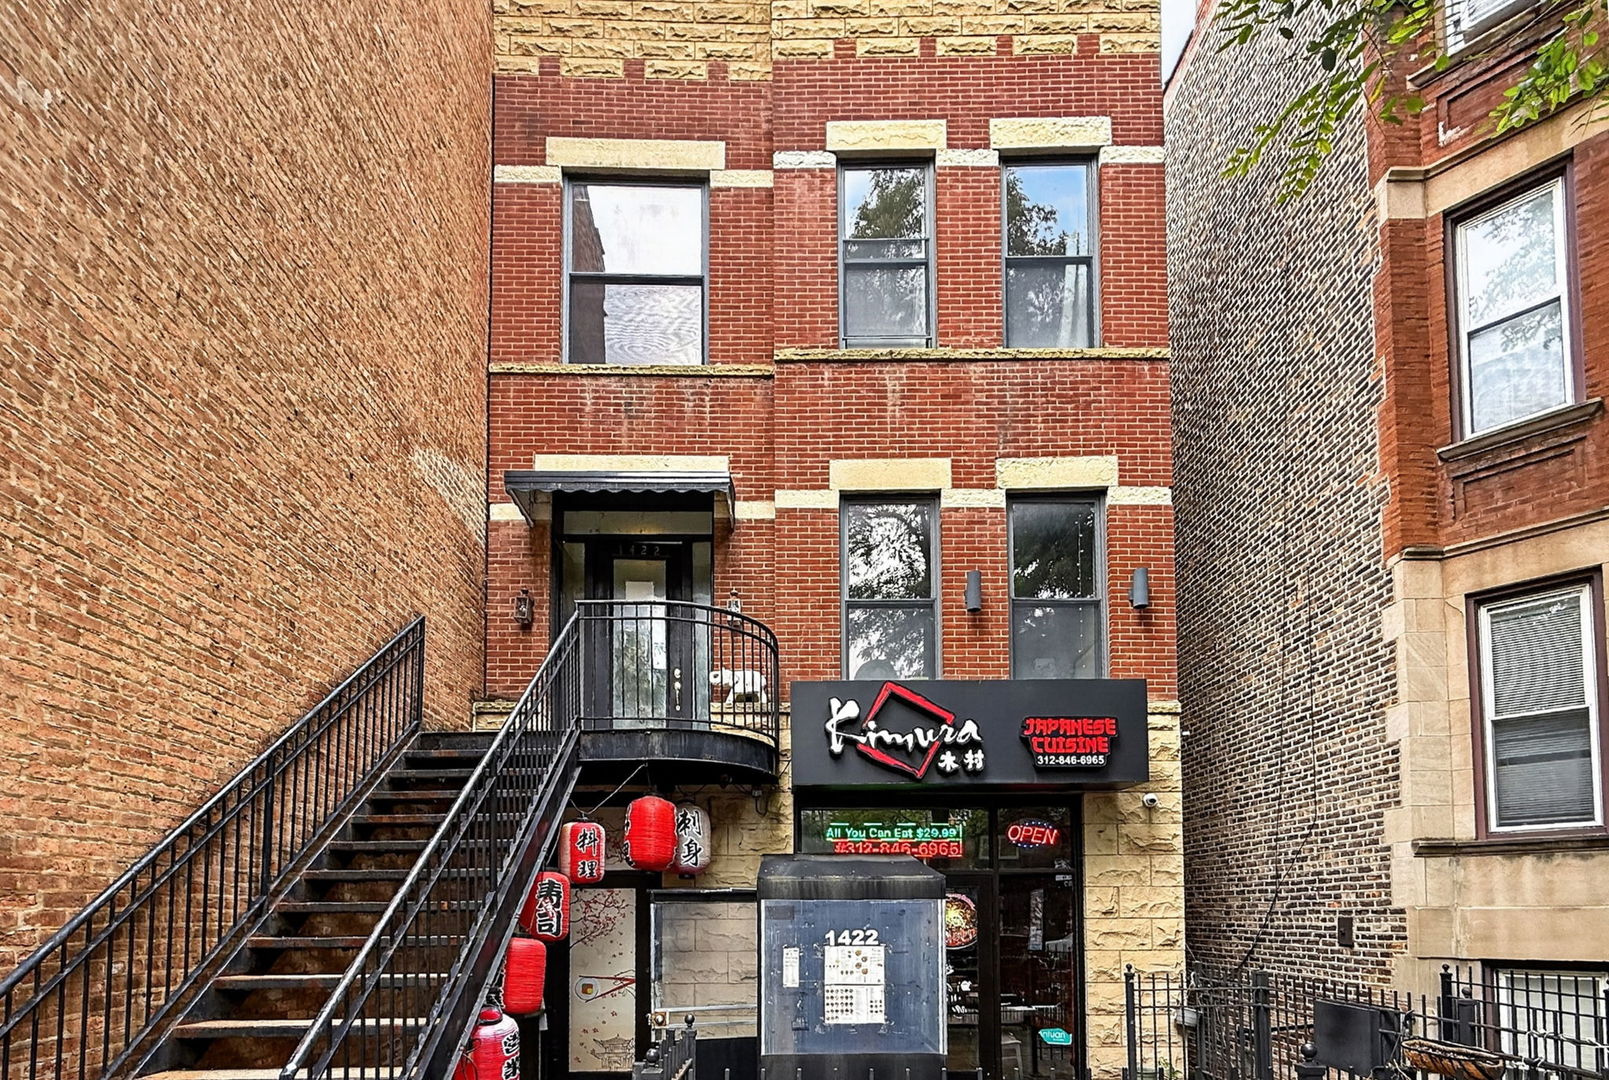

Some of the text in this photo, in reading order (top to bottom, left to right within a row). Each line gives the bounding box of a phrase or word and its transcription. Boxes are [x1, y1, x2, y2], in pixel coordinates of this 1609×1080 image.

[825, 697, 983, 753] Kimura
[1023, 718, 1117, 735] JAPANESE
[1031, 736, 1109, 753] CUISINE
[938, 749, 985, 772] 木村
[1037, 755, 1105, 765] 312-846-6965
[677, 808, 703, 867] 刺身
[826, 827, 958, 838] All You Can Eat $29.99
[1008, 825, 1058, 844] OPEN
[576, 828, 599, 878] 料理
[536, 879, 563, 936] 寿司
[825, 929, 879, 945] 1422
